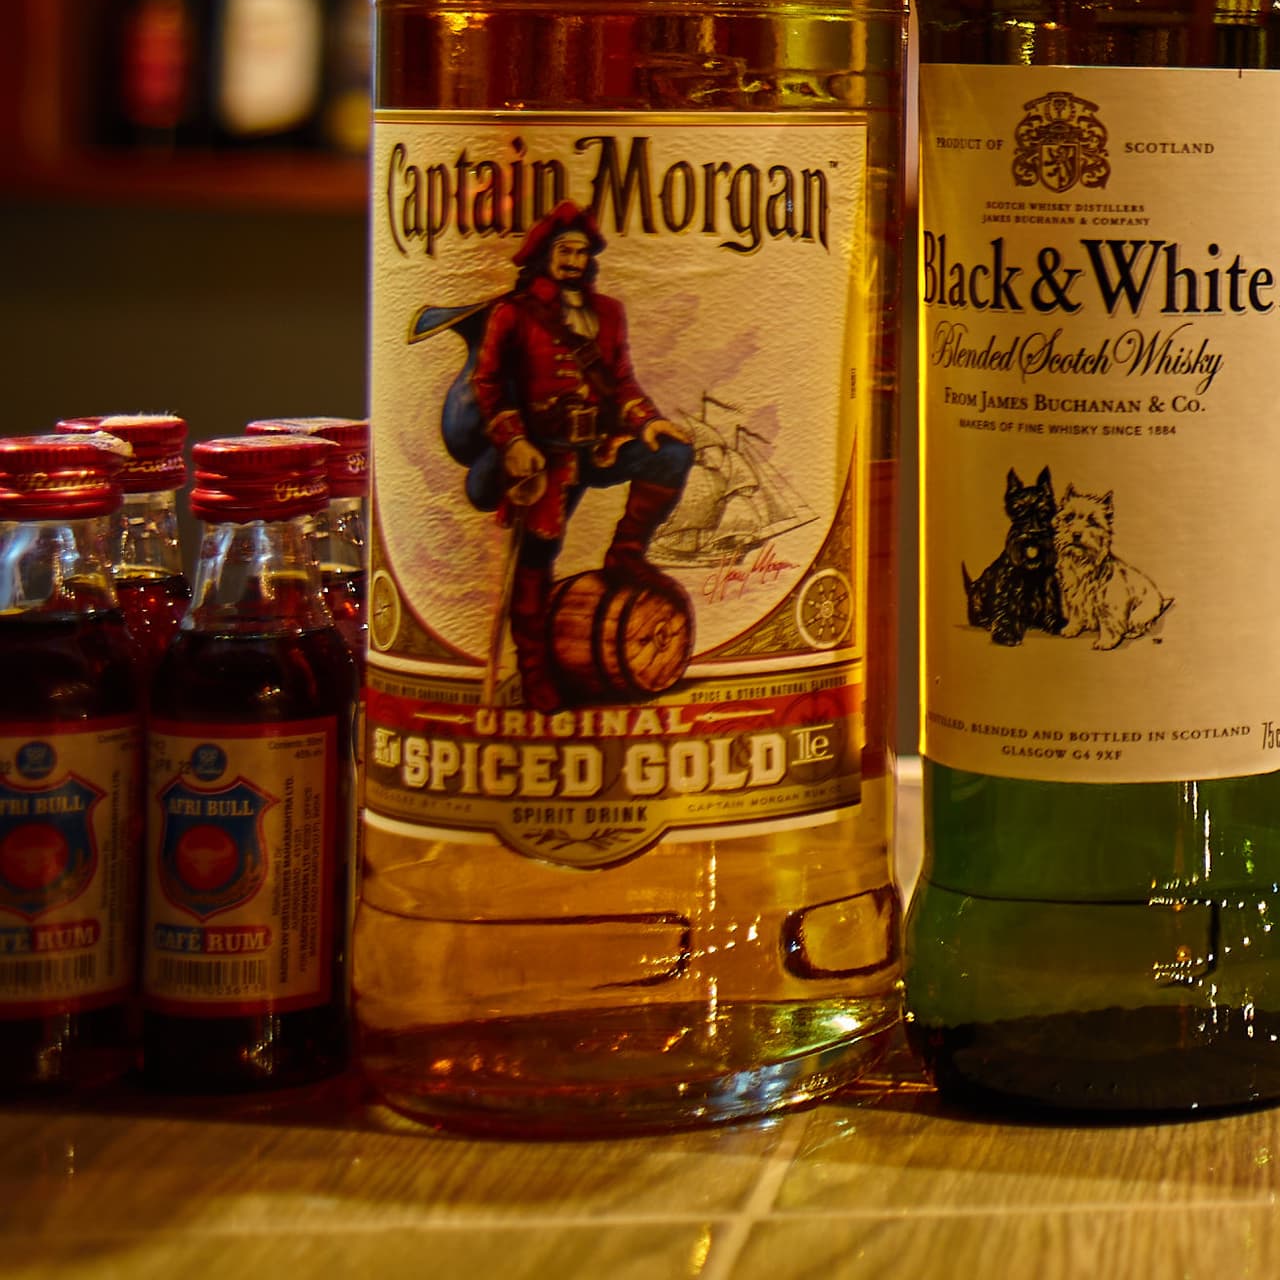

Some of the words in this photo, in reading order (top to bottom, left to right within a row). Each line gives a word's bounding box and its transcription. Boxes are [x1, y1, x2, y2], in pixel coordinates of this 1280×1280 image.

[936, 137, 982, 152] PRODUCT
[986, 139, 1004, 151] OF
[1124, 142, 1215, 155] SCOTLAND
[386, 136, 571, 258] Captain
[575, 136, 831, 254] Morgan
[985, 201, 1025, 212] SCOTCH
[1029, 202, 1072, 213] WHISKY
[1075, 203, 1145, 214] DISTILLERS
[981, 214, 1011, 225] JAMES
[1014, 215, 1075, 226] BUCHANAN
[1092, 217, 1150, 226] COMPANY
[932, 320, 1024, 375] Blended
[1020, 328, 1112, 384] Scotch
[1112, 322, 1225, 395] Whisky
[1148, 396, 1167, 413] &
[959, 418, 996, 431] MAKERS
[999, 421, 1013, 433] OF
[1017, 423, 1044, 435] FINE
[1048, 424, 1098, 436] WHISKY
[1102, 425, 1143, 436] SINCE
[1148, 425, 1177, 436] 1884
[690, 689, 721, 703] SPICE
[473, 706, 699, 738] ORIGINAL
[971, 722, 1029, 739] BLENDED
[1033, 726, 1064, 742] AND
[1069, 729, 1143, 743] BOTTLED
[1147, 729, 1166, 742] IN
[1171, 724, 1251, 741] SCOTLAND
[1001, 746, 1067, 760] GLASGOW
[1072, 748, 1091, 761] G4
[404, 736, 604, 798] SPICED
[623, 732, 788, 796] GOLD
[0, 798, 28, 816] FRI
[35, 795, 86, 815] BULL
[207, 800, 255, 817] BULL
[751, 793, 799, 806] MORGAN
[513, 807, 576, 825] SPIRIT
[585, 806, 648, 824] DRINK
[36, 927, 95, 951] RUM
[206, 932, 267, 953] RUM
